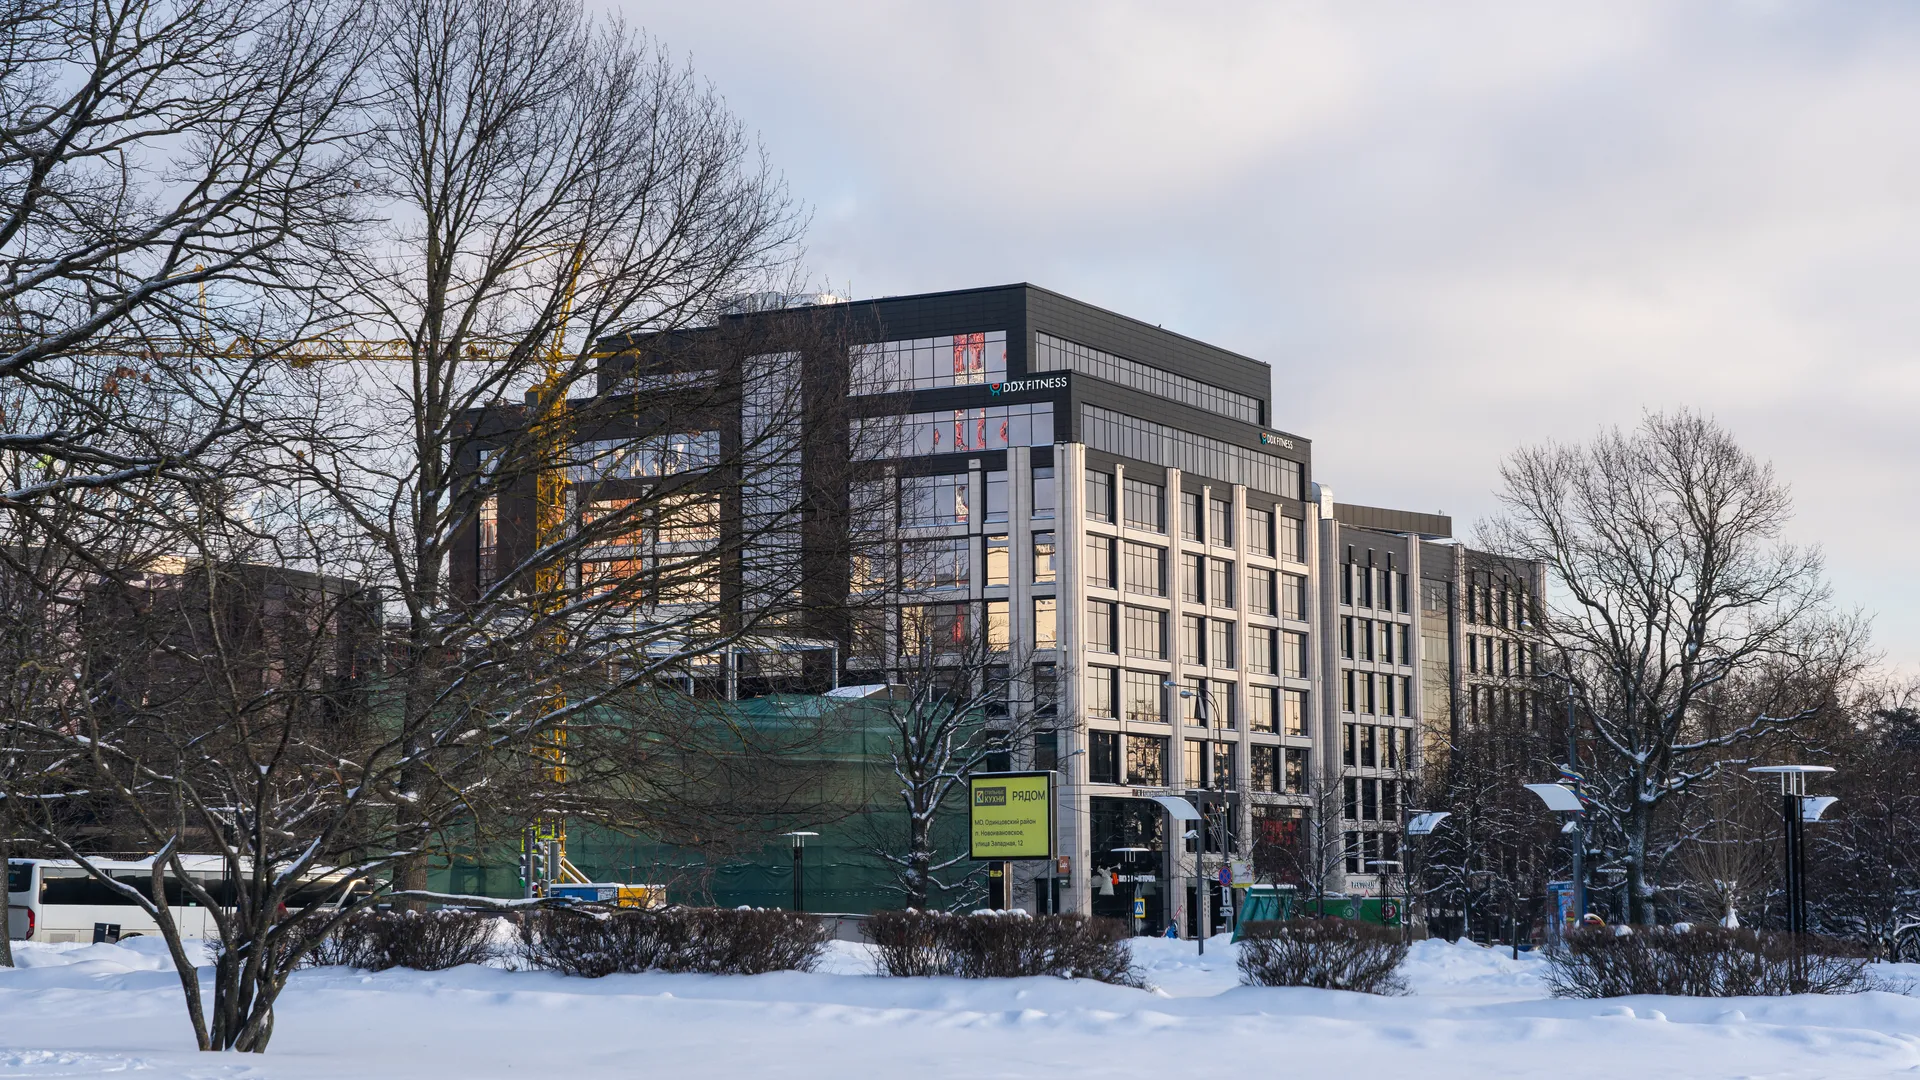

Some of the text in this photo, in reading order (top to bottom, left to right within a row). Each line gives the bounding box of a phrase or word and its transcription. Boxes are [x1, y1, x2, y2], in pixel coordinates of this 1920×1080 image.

[1003, 377, 1067, 392] DDX FITNESS
[984, 795, 1004, 803] КУХНИ
[1012, 790, 1045, 802] РЯДОМ
[985, 818, 1019, 826] Одинцовский
[1019, 818, 1036, 826] район
